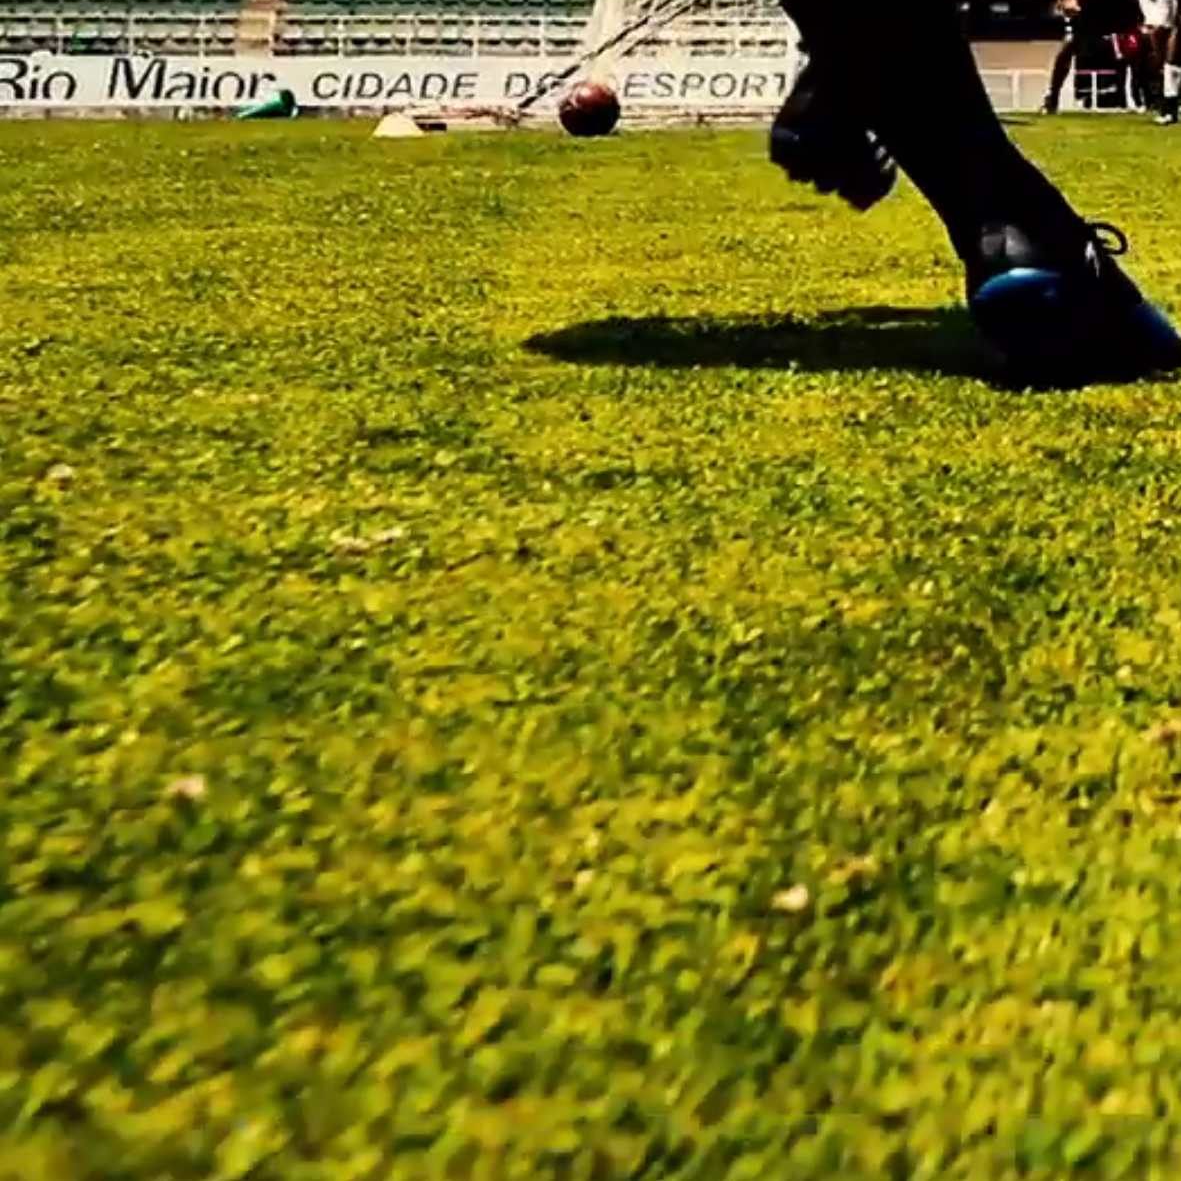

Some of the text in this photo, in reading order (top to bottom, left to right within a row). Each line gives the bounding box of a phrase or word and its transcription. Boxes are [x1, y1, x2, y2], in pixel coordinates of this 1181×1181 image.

[0, 58, 77, 100] Rio
[108, 58, 277, 100] Maior
[312, 72, 478, 99] CIDADE
